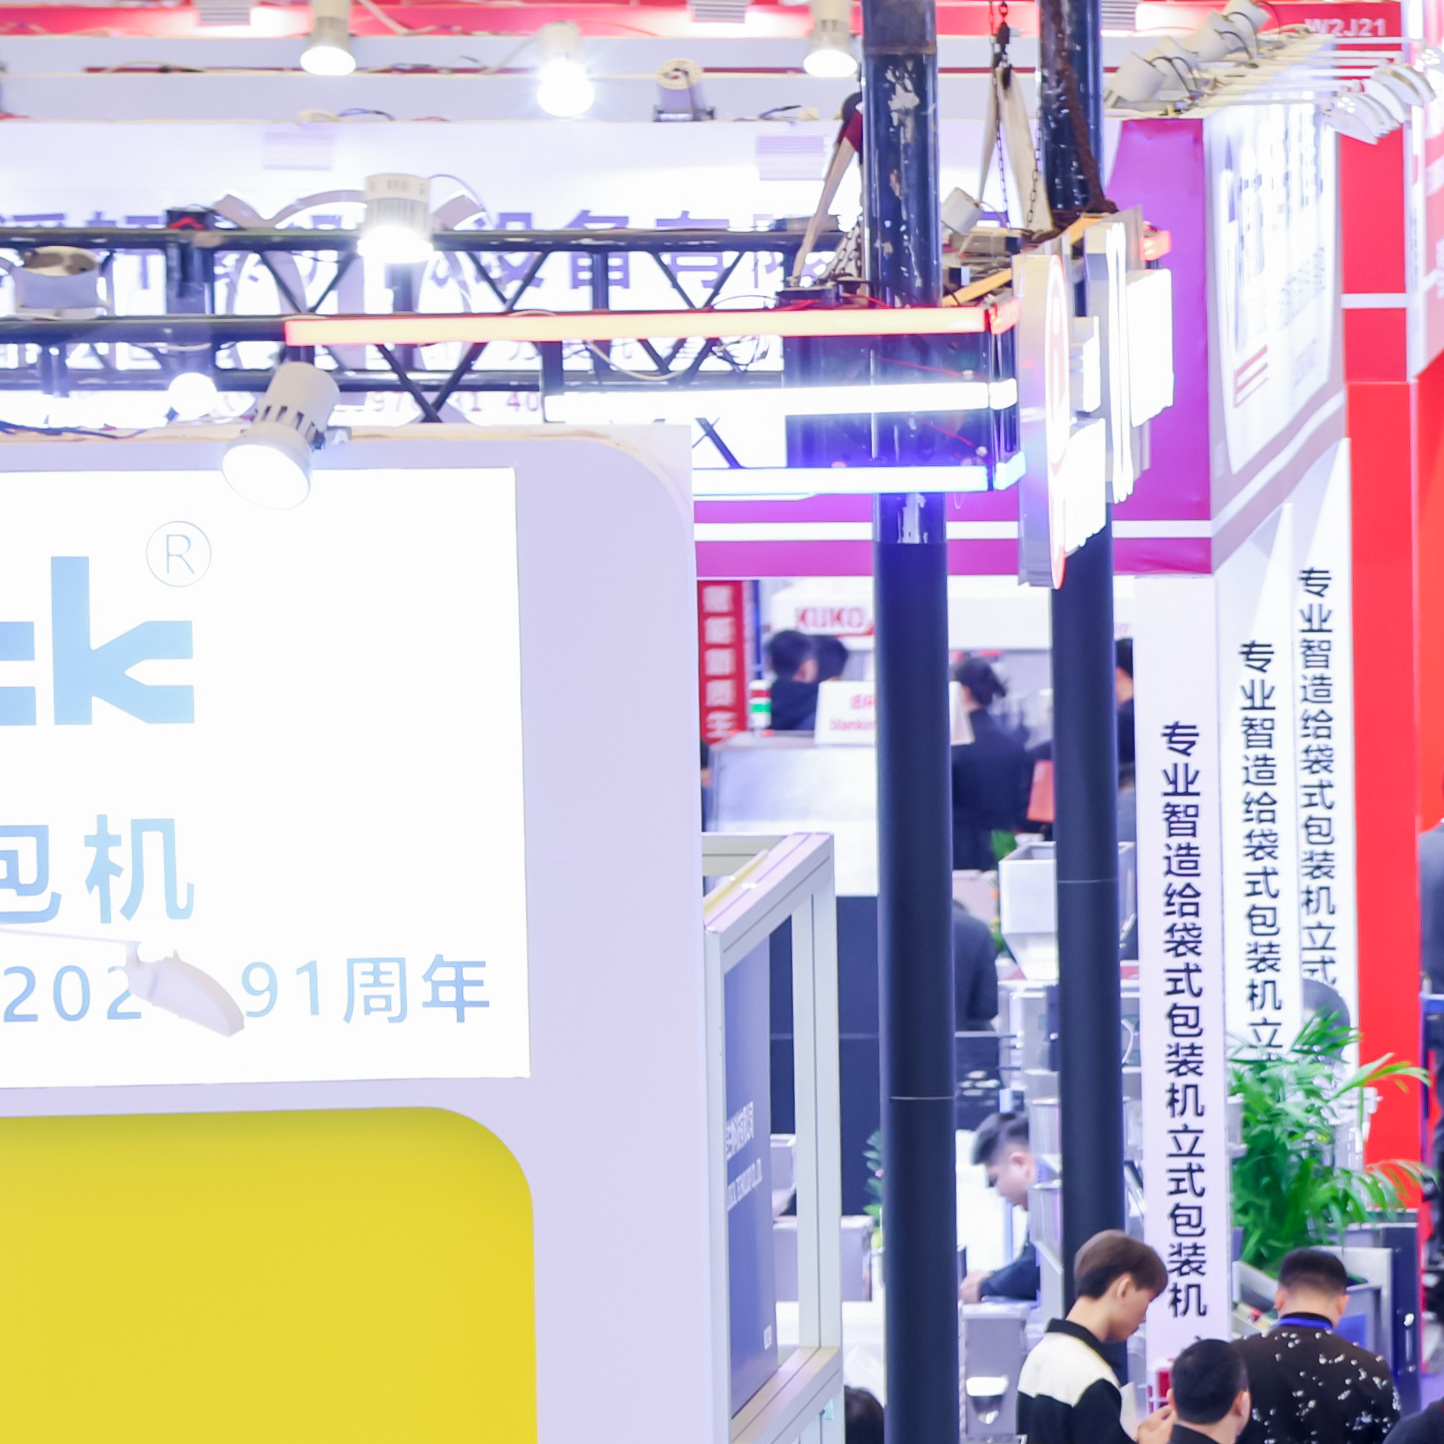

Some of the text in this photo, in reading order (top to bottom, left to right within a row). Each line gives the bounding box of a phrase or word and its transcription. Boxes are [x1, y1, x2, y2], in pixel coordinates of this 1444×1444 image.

[3, 964, 150, 1024] 202
[1161, 720, 1208, 1318] 专业智造给袋式包装机立式包装机
[1239, 640, 1283, 1052] 专业智造给袋式包装机立
